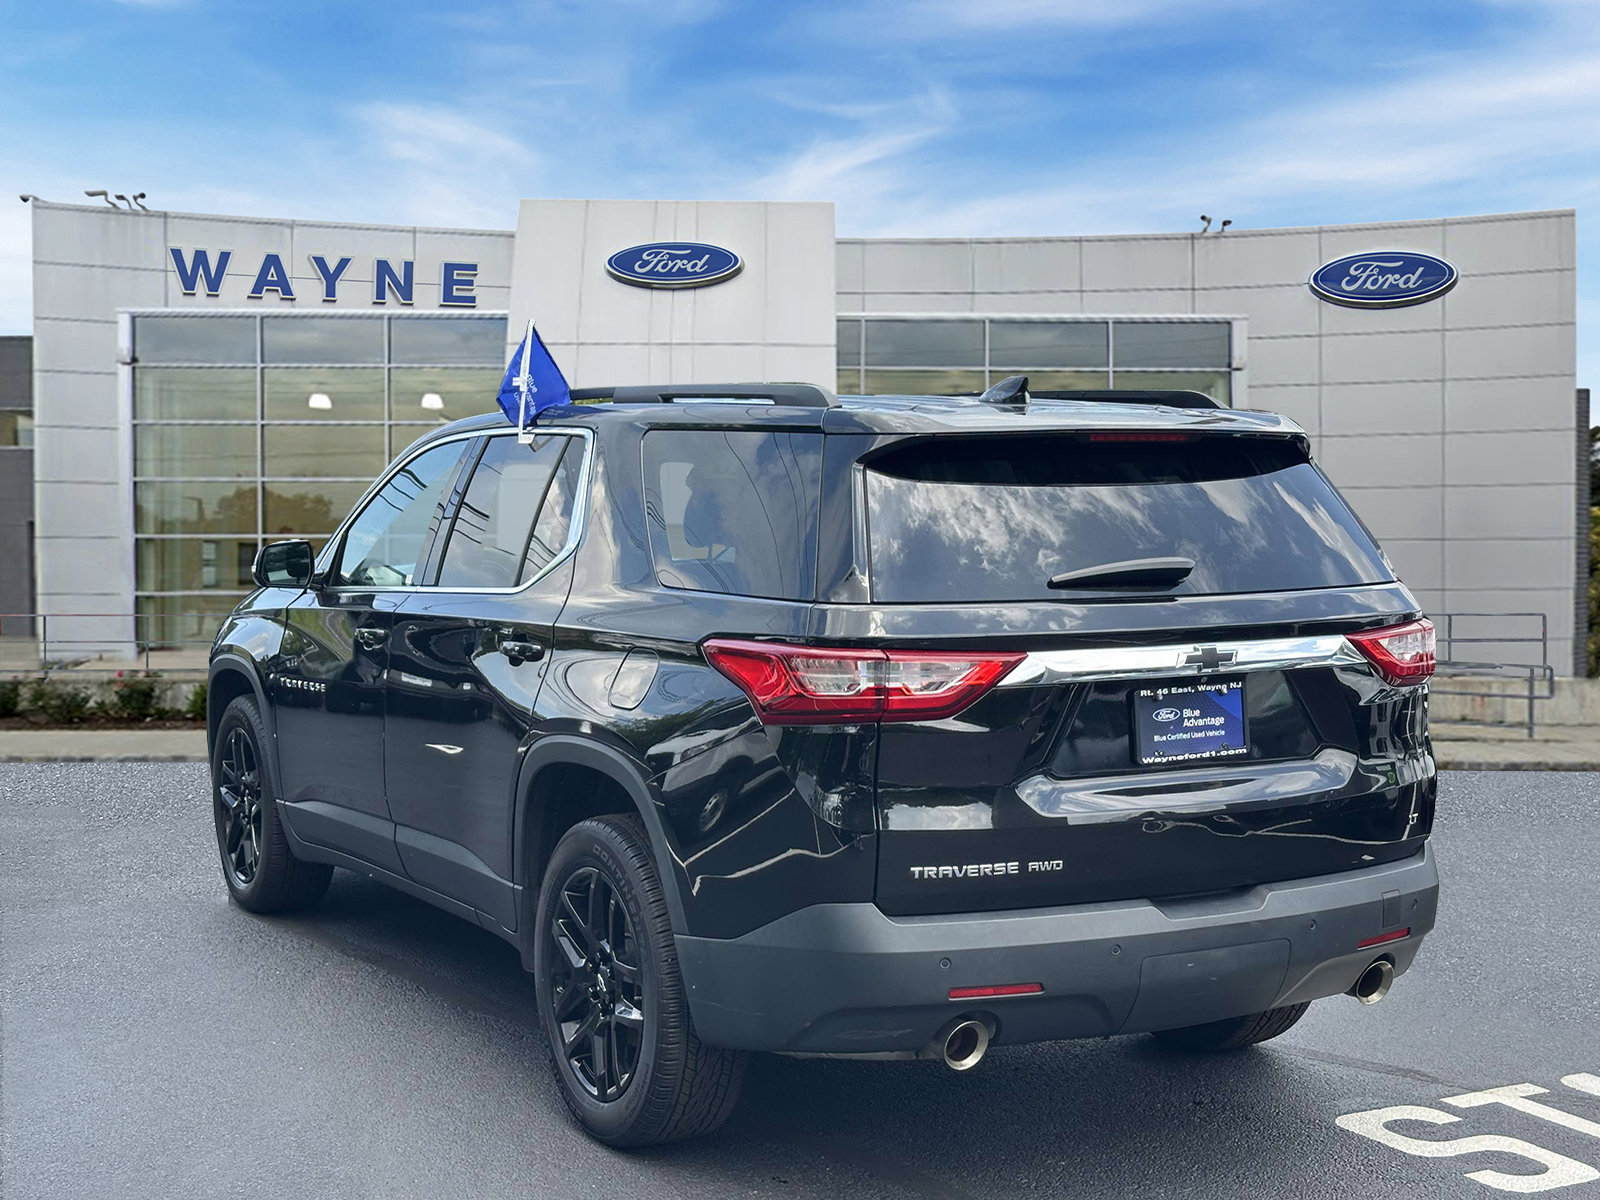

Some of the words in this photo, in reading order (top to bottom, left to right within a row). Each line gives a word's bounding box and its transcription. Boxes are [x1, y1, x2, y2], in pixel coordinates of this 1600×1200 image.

[634, 248, 711, 273] Ford
[168, 246, 478, 307] WAYNE
[1341, 261, 1425, 291] Ford
[1140, 689, 1154, 697] Rt.
[1157, 688, 1169, 696] 46
[1171, 686, 1195, 694] East,
[1197, 683, 1228, 692] Wayne
[1182, 708, 1201, 718] Blue
[1182, 716, 1225, 728] Advantage
[1167, 732, 1190, 741] Certified
[1191, 731, 1206, 739] Used
[1206, 729, 1226, 737] Vehicle
[1142, 748, 1247, 764] Wayneford1.com
[910, 862, 1020, 879] TRAVERSE
[1027, 859, 1063, 873] AWD
